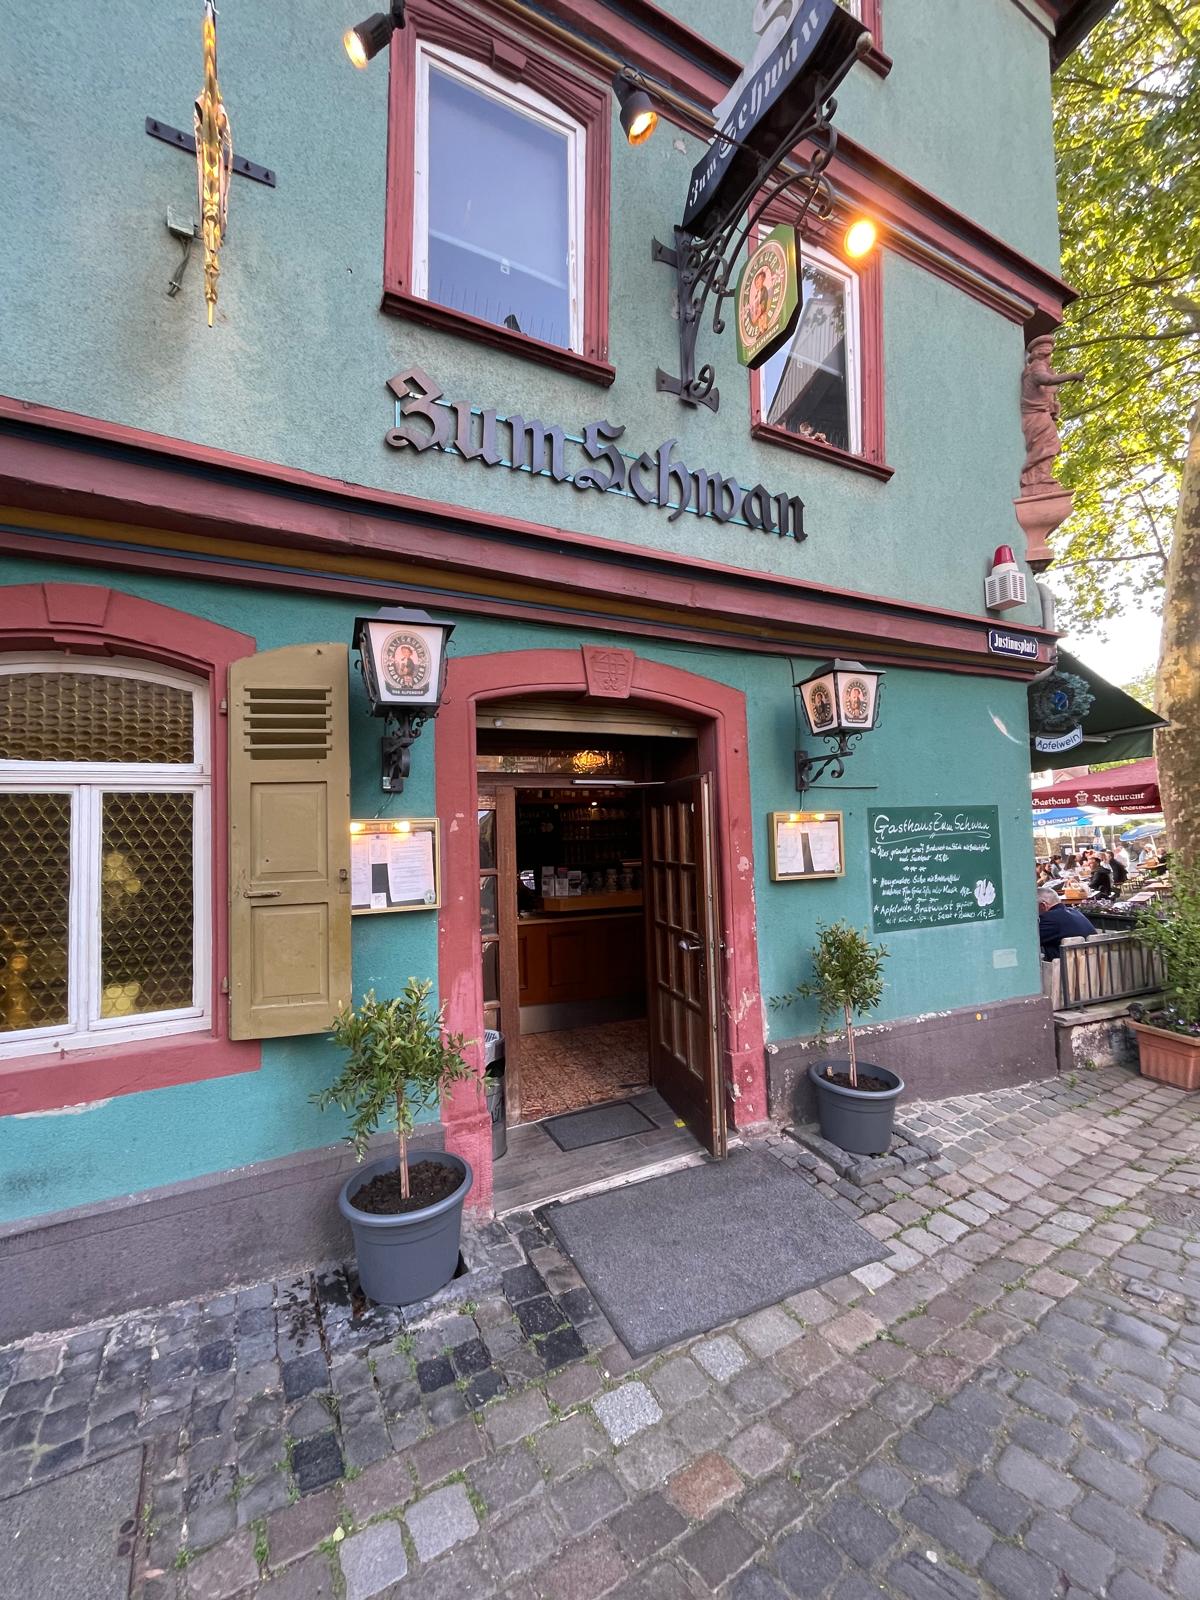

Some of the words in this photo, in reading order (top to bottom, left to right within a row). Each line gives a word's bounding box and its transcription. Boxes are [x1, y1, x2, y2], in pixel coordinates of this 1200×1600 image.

[689, 159, 717, 207] Zum
[719, 8, 819, 159] Schwan
[385, 367, 571, 482] Zum
[574, 419, 808, 542] Schwan
[994, 633, 1036, 654] Justinusplatz
[1036, 733, 1081, 751] Apfelwein
[1031, 797, 1071, 807] Gasthaus
[1092, 792, 1145, 803] Restaurant
[874, 814, 932, 840] Gasthaus
[954, 813, 990, 830] Schwan
